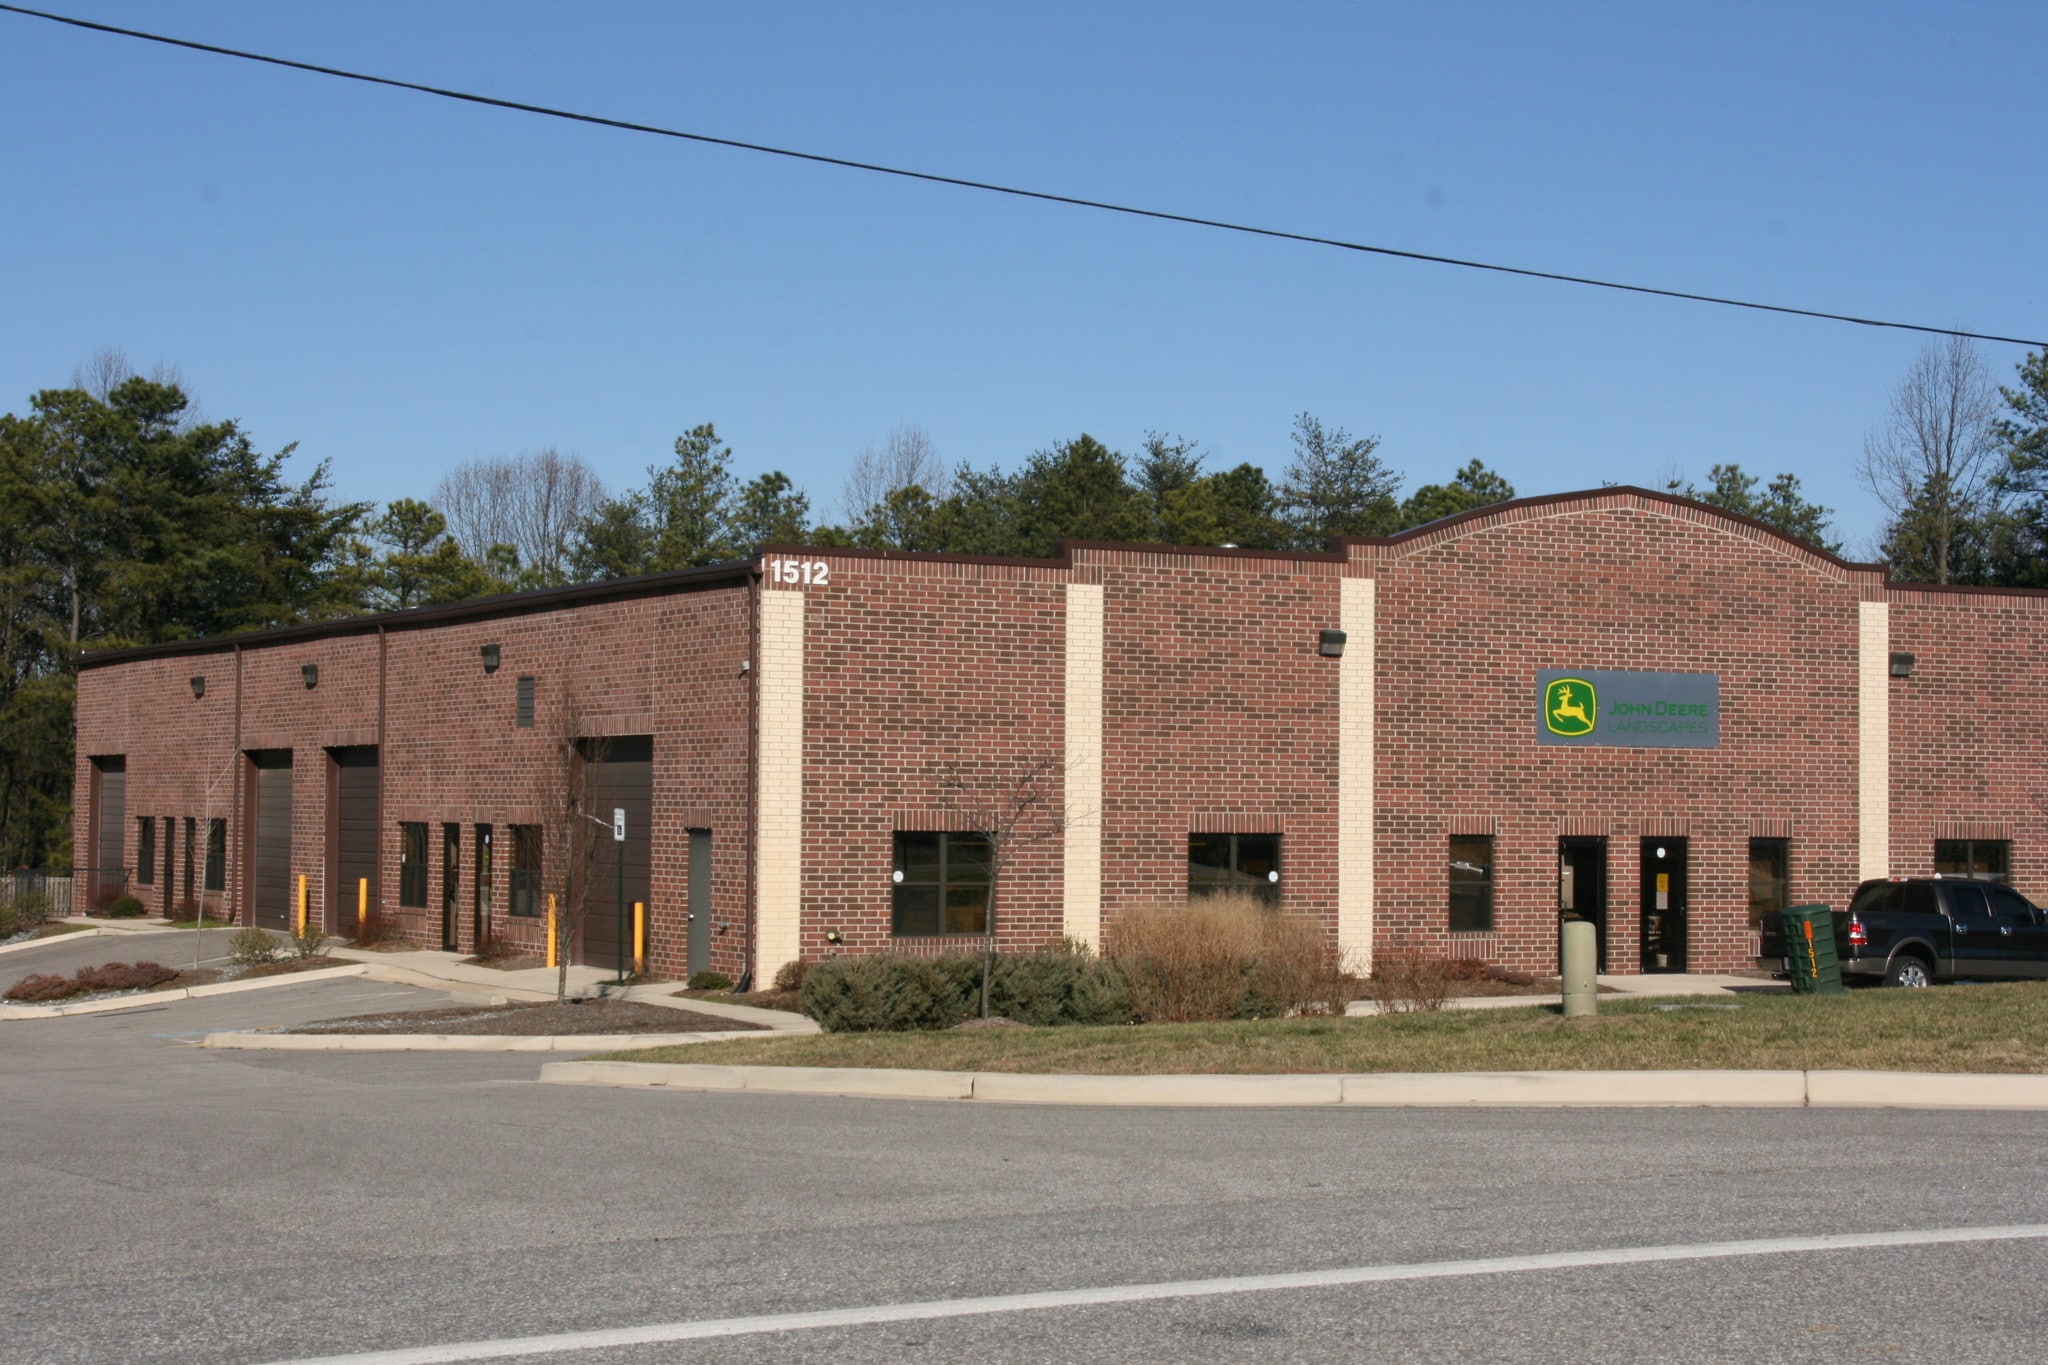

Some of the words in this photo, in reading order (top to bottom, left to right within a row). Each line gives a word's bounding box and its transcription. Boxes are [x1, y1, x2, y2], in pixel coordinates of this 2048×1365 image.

[771, 560, 829, 585] 1512
[1608, 701, 1652, 716] JOHN
[1655, 701, 1708, 717] DEERE
[1608, 720, 1708, 734] LANDSCAPES
[1807, 939, 1818, 978] 1512
